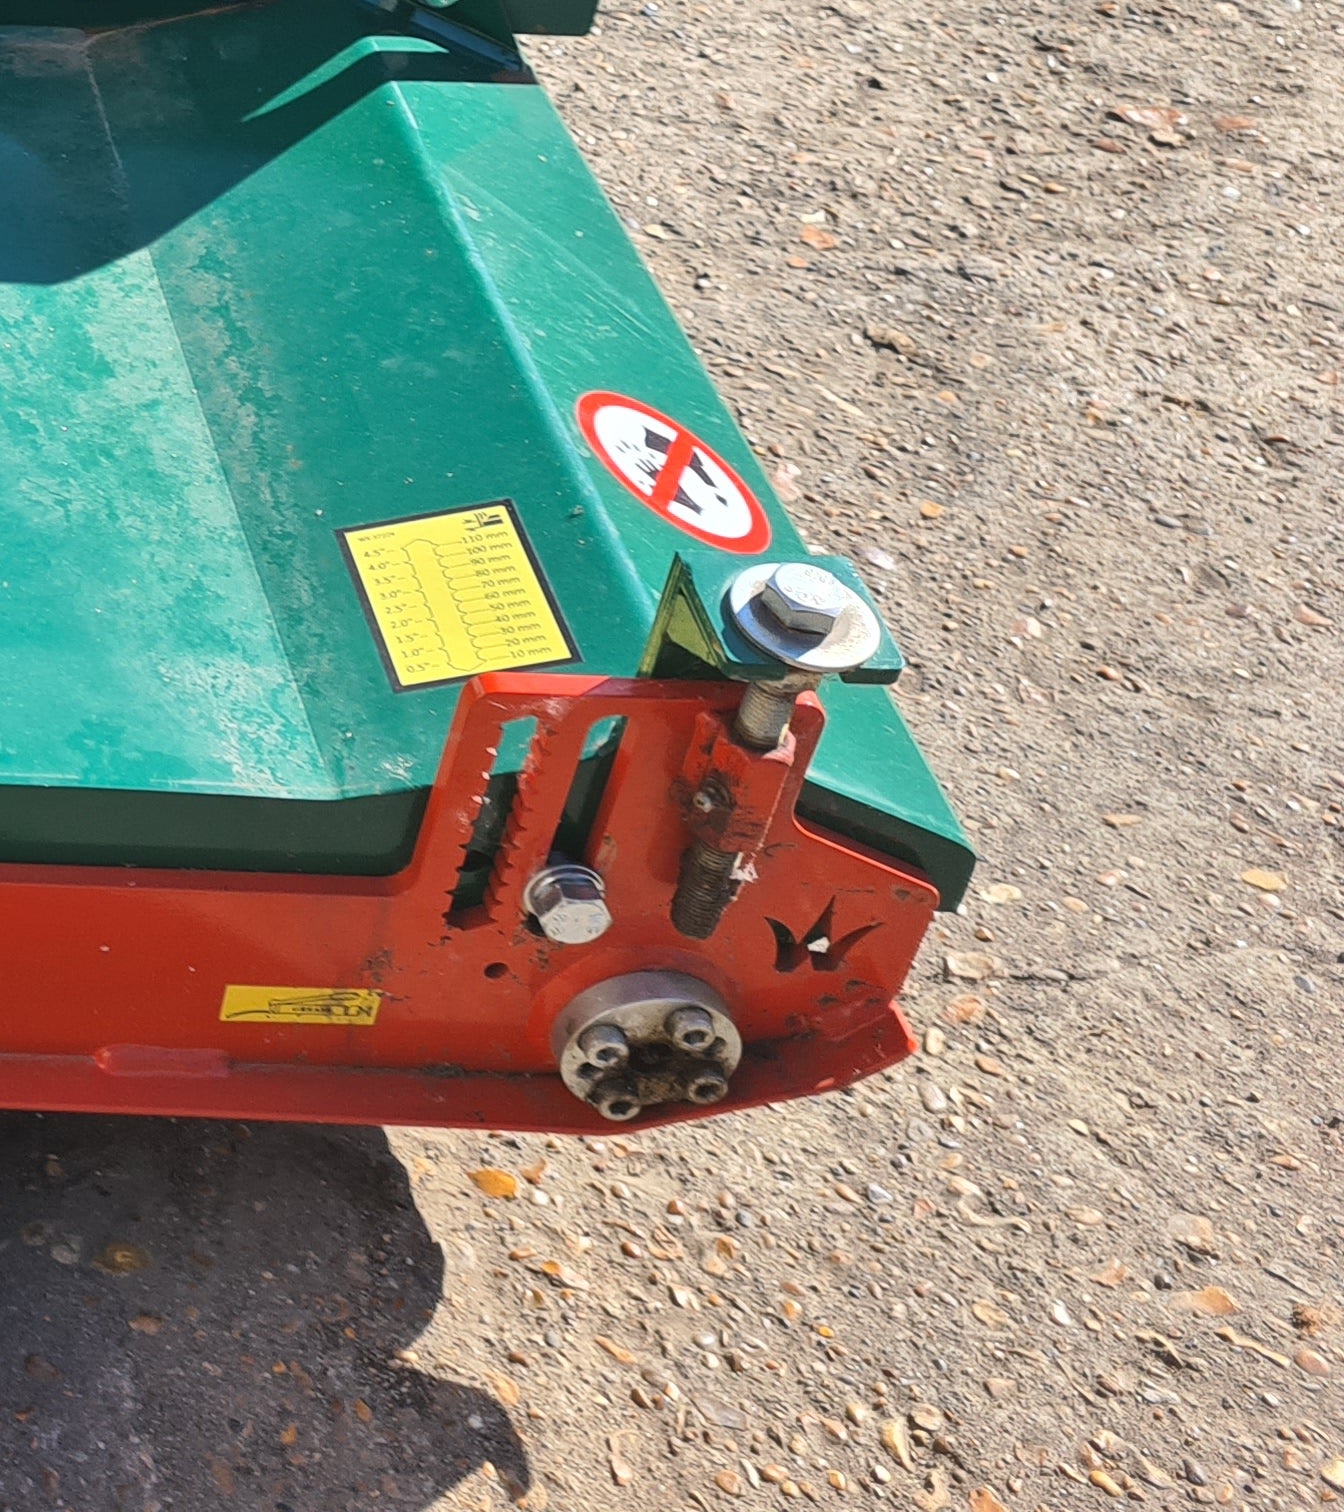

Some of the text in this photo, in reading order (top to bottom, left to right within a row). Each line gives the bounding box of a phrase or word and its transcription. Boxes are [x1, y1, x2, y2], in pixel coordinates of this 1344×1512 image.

[486, 531, 508, 540] mm
[489, 542, 512, 550] mm
[488, 554, 510, 563] mm
[492, 566, 516, 574] mm
[497, 577, 520, 586] mm
[502, 588, 526, 597] mm
[507, 600, 531, 608] mm
[512, 612, 536, 620] mm
[518, 623, 542, 632] mm
[522, 634, 546, 644] mm
[528, 647, 552, 656] mm
